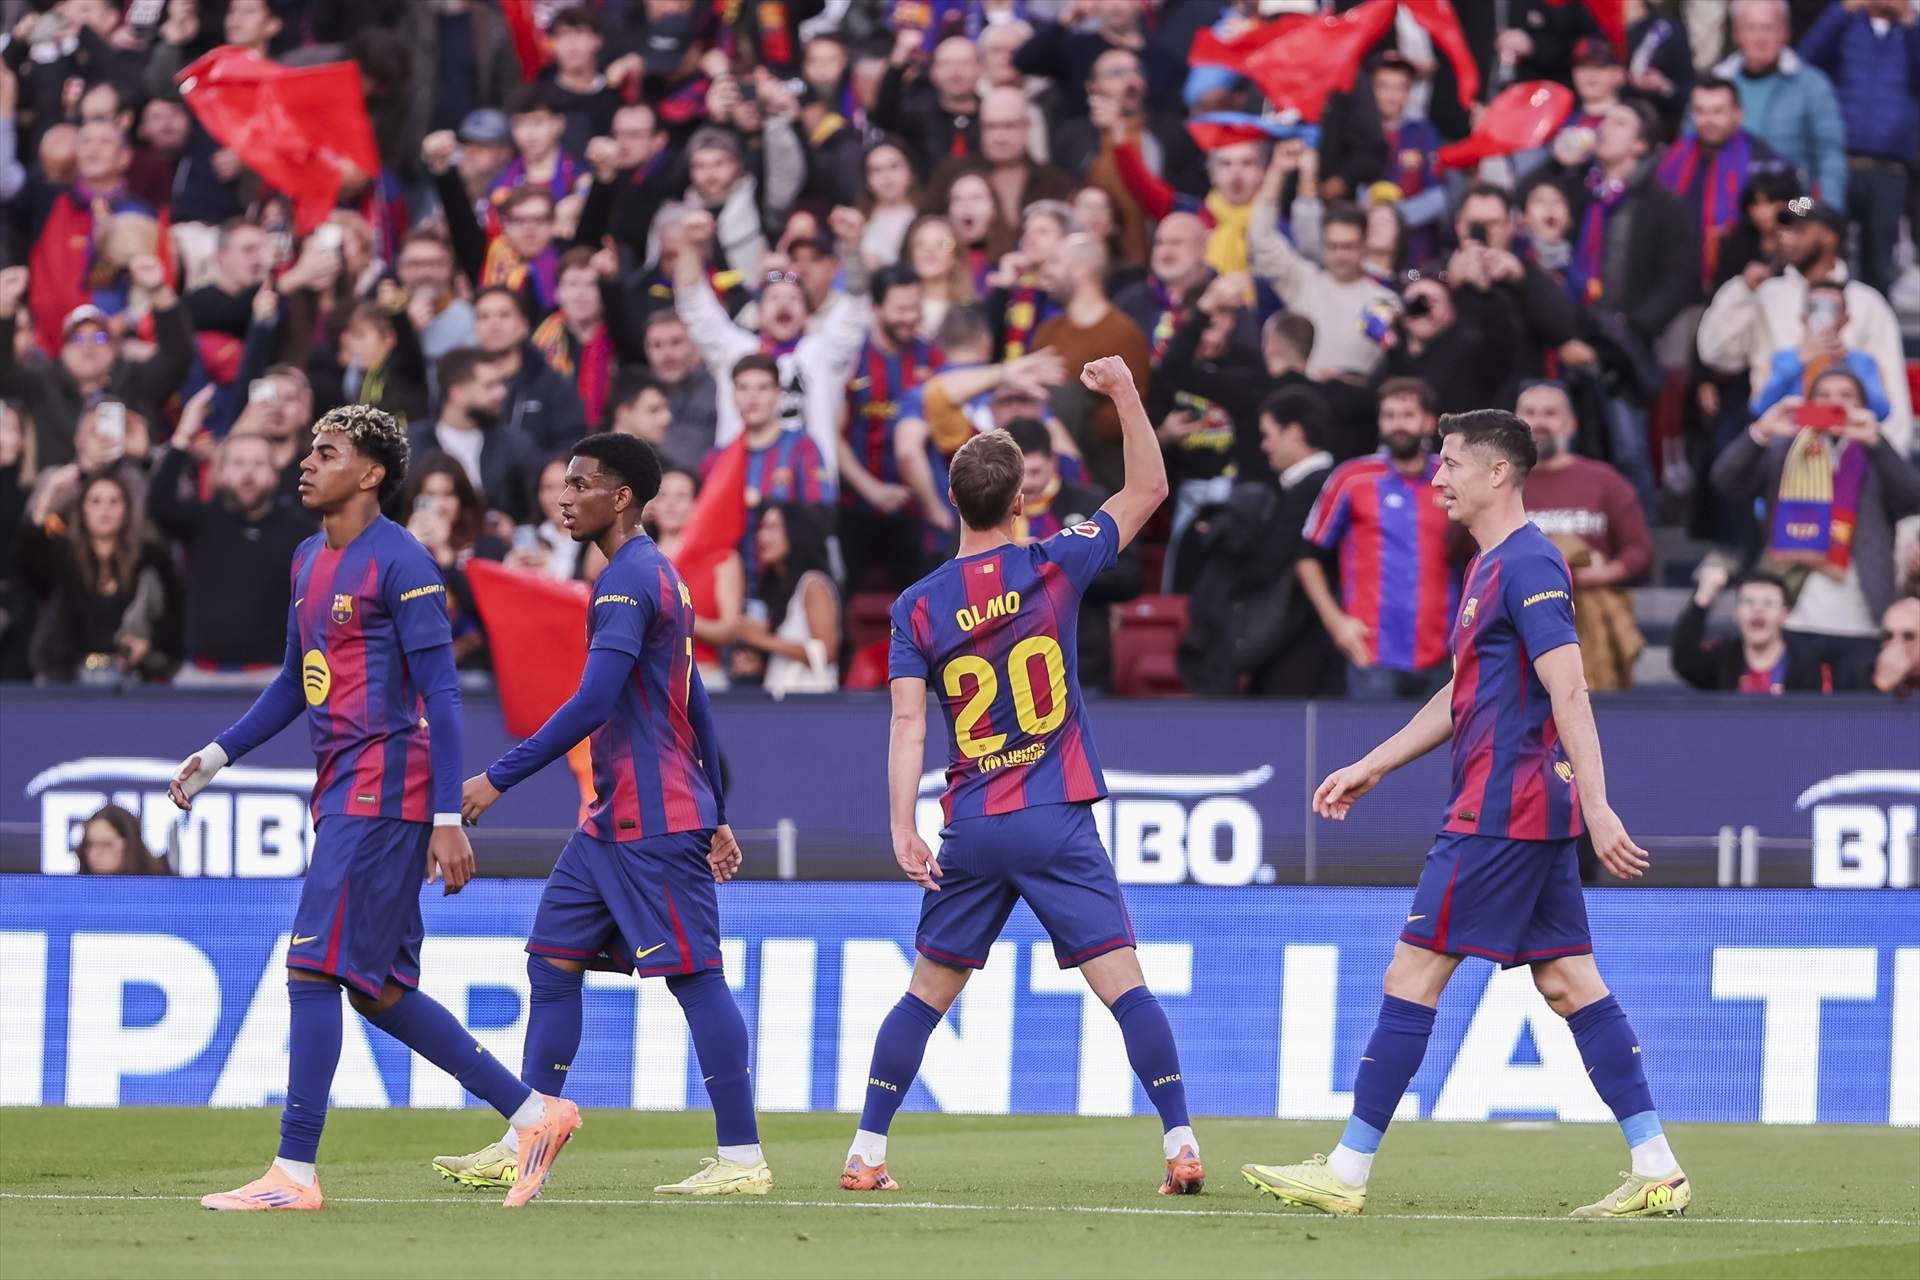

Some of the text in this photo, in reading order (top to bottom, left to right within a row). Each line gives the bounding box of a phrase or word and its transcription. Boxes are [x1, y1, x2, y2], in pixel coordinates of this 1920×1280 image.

[955, 591, 1020, 632] OLMO
[943, 635, 1067, 758] 20
[1278, 944, 1621, 1123] LA
